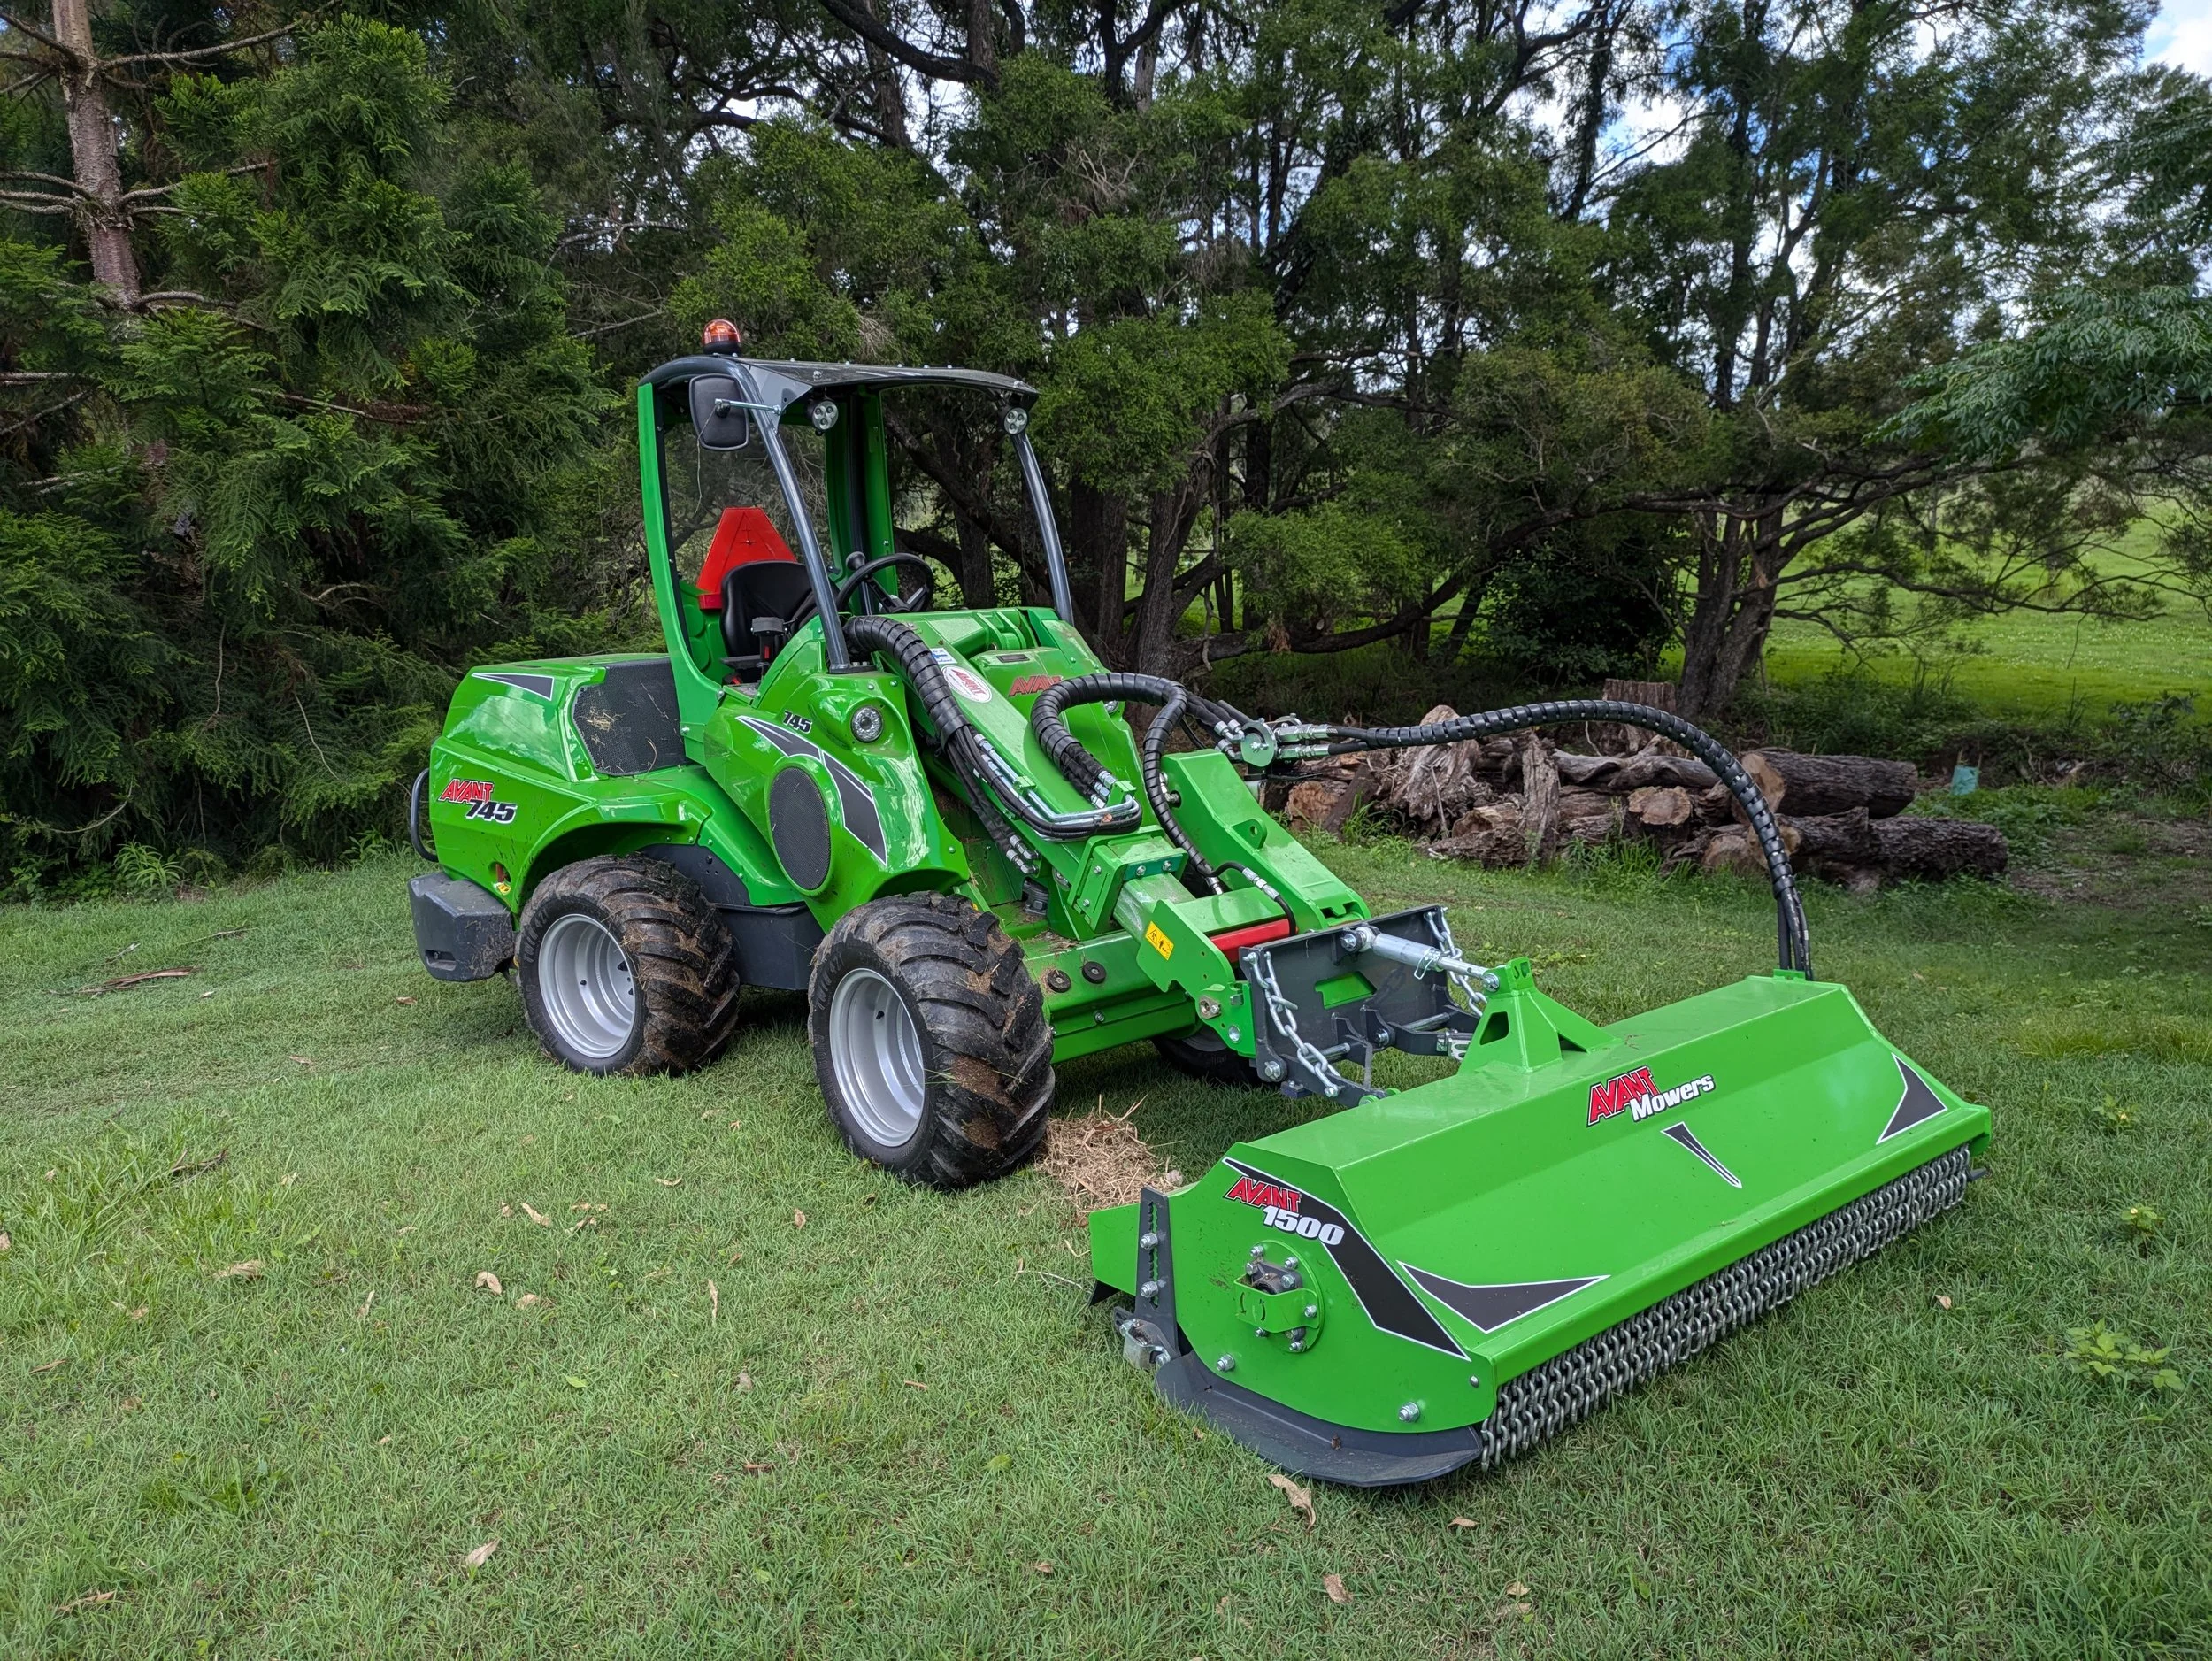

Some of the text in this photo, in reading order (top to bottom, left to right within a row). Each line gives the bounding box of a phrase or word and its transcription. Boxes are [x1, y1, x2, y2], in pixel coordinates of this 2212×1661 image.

[783, 710, 812, 734] 745
[438, 779, 494, 804] AVANT
[465, 799, 518, 824] 745
[1587, 1065, 1661, 1126] AVANT
[1630, 1075, 1715, 1121] Mowers
[1225, 1177, 1301, 1212] AVANT
[1263, 1205, 1346, 1246] 1500
